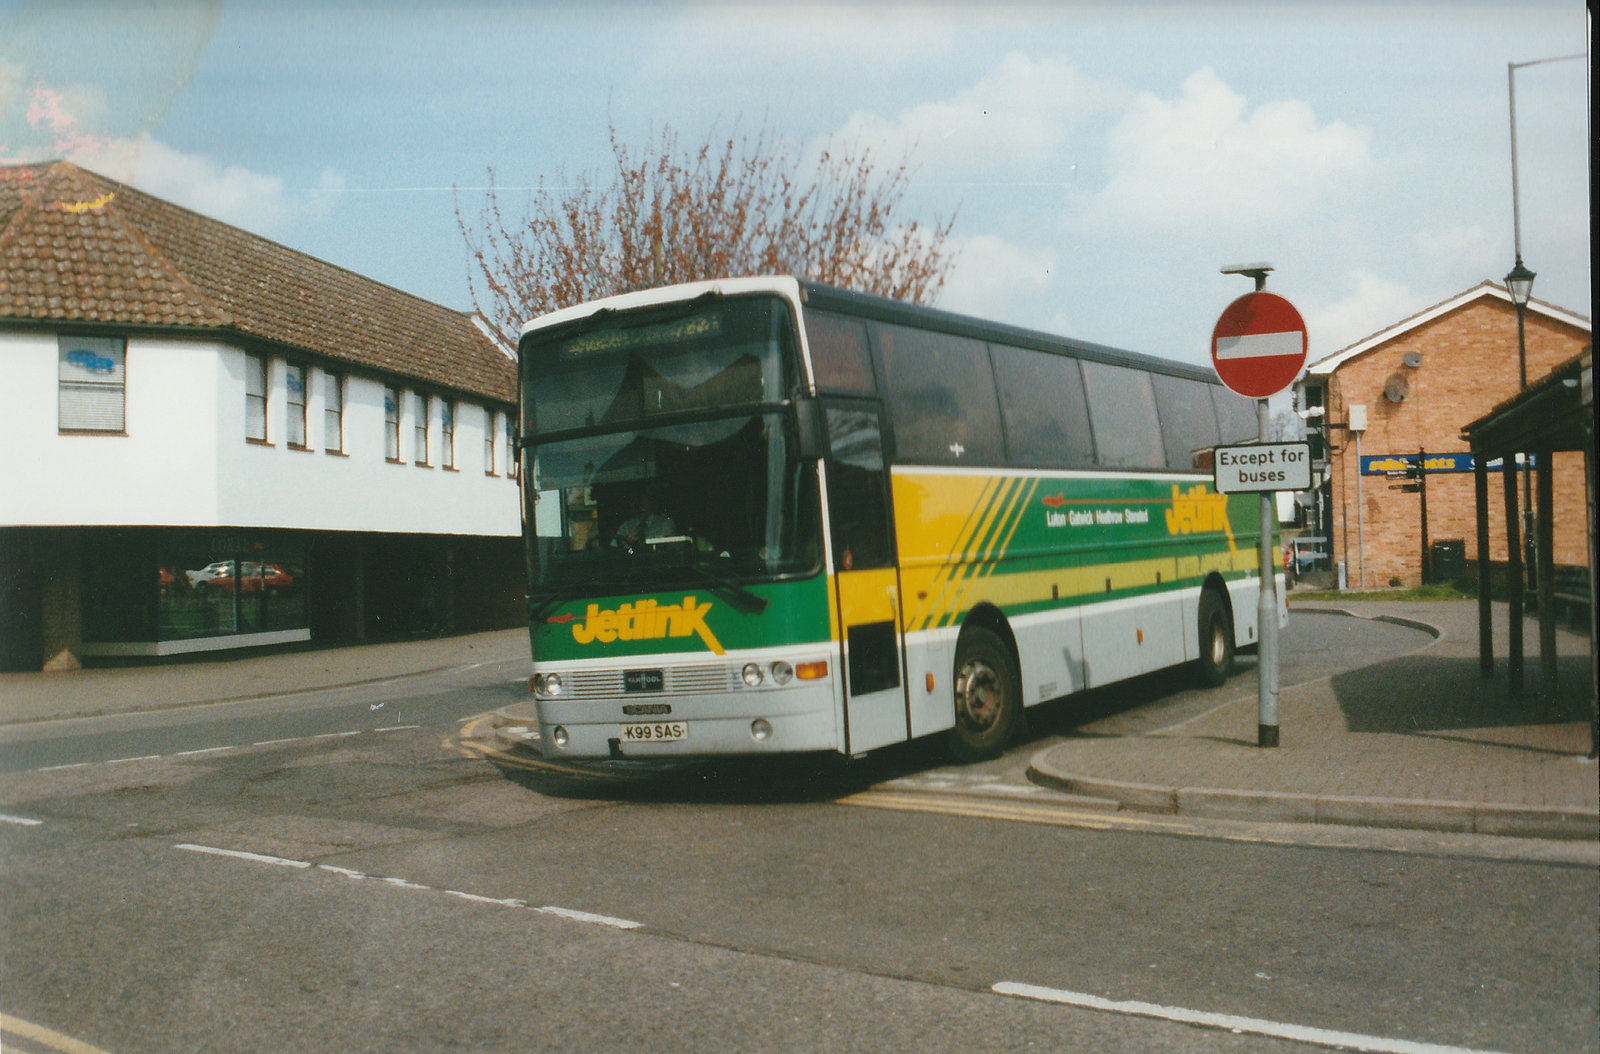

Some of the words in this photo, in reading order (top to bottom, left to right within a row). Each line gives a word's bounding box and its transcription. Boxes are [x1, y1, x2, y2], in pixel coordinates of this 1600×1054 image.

[1220, 450, 1275, 466] Except
[1281, 448, 1304, 463] for
[1239, 469, 1286, 482] buses
[1046, 510, 1066, 527] Luton
[1165, 484, 1237, 558] Jetlink
[572, 596, 727, 655] Jetlink
[626, 726, 652, 739] K99
[655, 724, 682, 739] SAS
